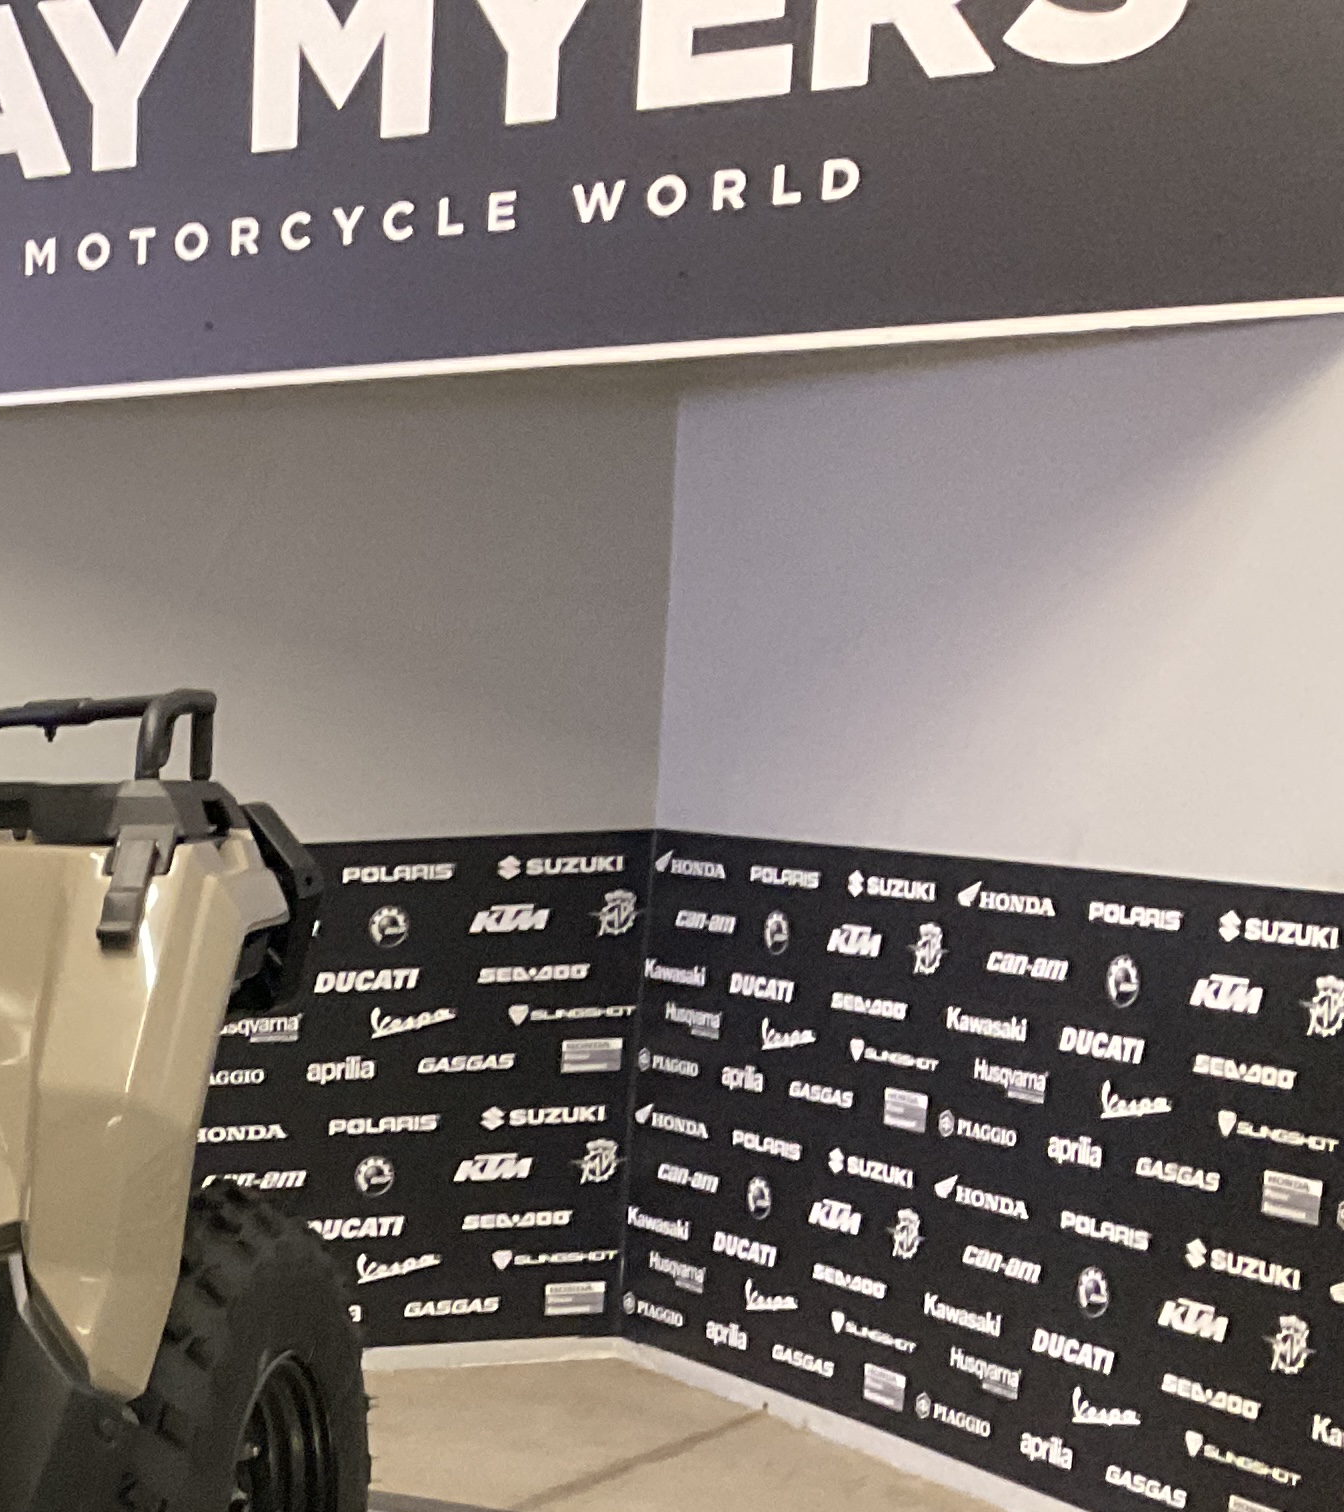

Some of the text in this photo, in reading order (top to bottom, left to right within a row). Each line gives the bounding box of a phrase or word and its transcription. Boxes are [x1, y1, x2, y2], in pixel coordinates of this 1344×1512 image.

[24, 156, 863, 277] MOTORCYCLE WORLD
[342, 863, 456, 884] POLARIS
[526, 856, 624, 876] SUZUKI
[670, 858, 725, 879] HONDA
[749, 864, 821, 889] POLARIS
[866, 876, 936, 901] SUZUKI
[978, 891, 1056, 917] HONDA
[469, 903, 552, 934] KTM
[674, 909, 737, 935] can-am
[1088, 901, 1184, 932] POLARIS
[826, 923, 882, 957] KTM
[1244, 917, 1340, 949] SUZUKI
[314, 968, 421, 994] DUCATI
[644, 958, 706, 987] Kawasaki
[986, 951, 1069, 981] can-am
[729, 972, 795, 1003] DUCATI
[1189, 973, 1264, 1014] KTM
[370, 1007, 457, 1039] Vespa
[946, 1006, 1028, 1042] Kawasaki
[1058, 1027, 1146, 1065] DUCATI
[306, 1056, 377, 1085] aprilia
[417, 1053, 516, 1074] GASGAS
[651, 1054, 699, 1077] PIAGGIO
[721, 1064, 764, 1093] aprilia
[788, 1081, 854, 1109] GASGAS
[1099, 1080, 1173, 1118] Vespa
[328, 1114, 441, 1136] POLARIS
[509, 1106, 606, 1127] SUZUKI
[651, 1111, 709, 1139] HONDA
[957, 1117, 1017, 1147] PIAGGIO
[732, 1129, 803, 1161] POLARIS
[1047, 1135, 1102, 1168] aprilia
[454, 1153, 534, 1182] KTM
[658, 1163, 719, 1194] can-am
[846, 1156, 914, 1189] SUZUKI
[1135, 1157, 1221, 1192] GASGAS
[808, 1198, 862, 1236] KTM
[955, 1185, 1029, 1220] HONDA
[627, 1206, 690, 1241] Kawasaki
[1060, 1210, 1151, 1251] POLARIS
[712, 1231, 778, 1268] DUCATI
[962, 1244, 1042, 1284] can-am
[356, 1253, 443, 1284] Vespa
[1210, 1249, 1302, 1291] SUZUKI
[403, 1296, 499, 1318] GASGAS
[637, 1300, 683, 1327] PIAGGIO
[923, 1292, 1002, 1337] Kawasaki
[1158, 1298, 1229, 1343] KTM
[706, 1320, 748, 1350] aprilia
[772, 1344, 835, 1378] GASGAS
[1032, 1328, 1115, 1376] DUCATI
[933, 1403, 991, 1438] PIAGGIO
[1072, 1386, 1141, 1425] Vespa
[1020, 1431, 1073, 1470] aprilia
[1105, 1465, 1188, 1510] GASGAS
